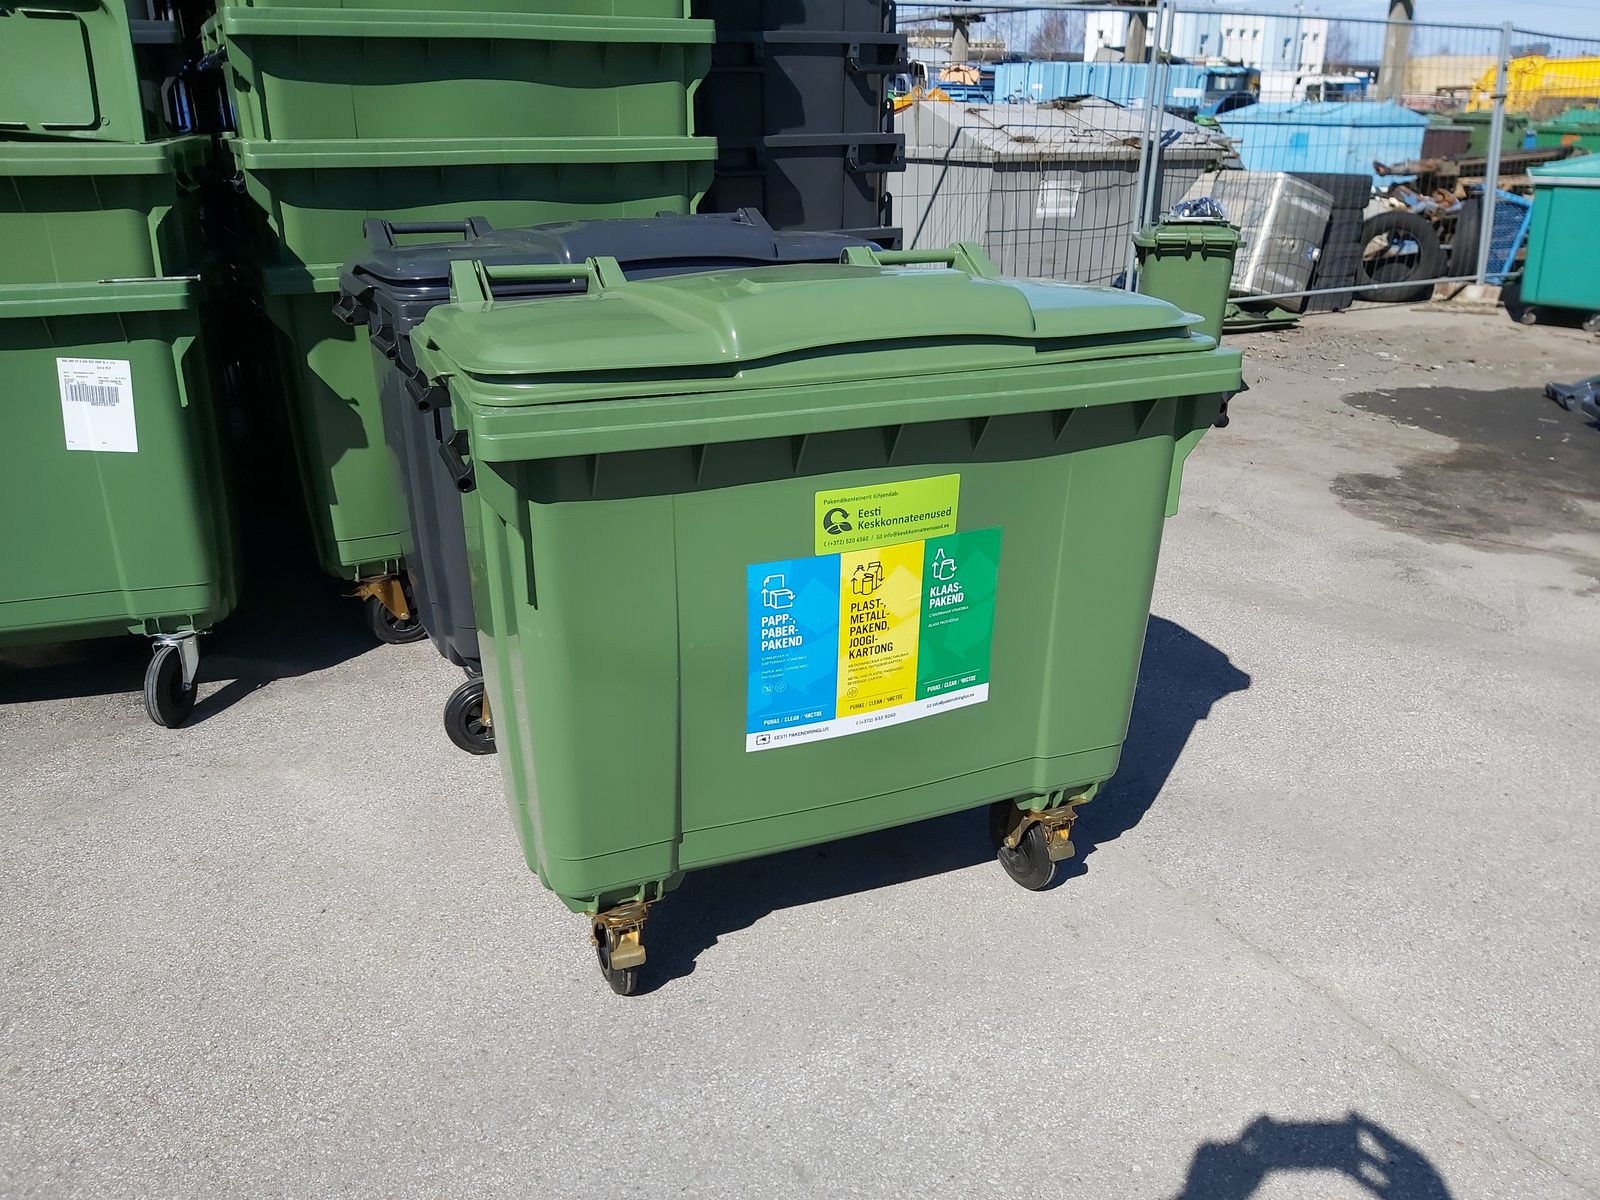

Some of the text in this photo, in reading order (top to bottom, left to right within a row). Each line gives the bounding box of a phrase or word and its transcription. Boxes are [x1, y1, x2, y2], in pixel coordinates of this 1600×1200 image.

[824, 491, 899, 505] Pakendikonteinerit tühjendab:
[858, 507, 881, 518] Eesti
[858, 507, 952, 530] Keskkonnateenused
[828, 538, 844, 547] (+372)
[884, 523, 949, 539] info@keskkonnateenused.ee
[930, 582, 963, 598] KLAAS-
[850, 598, 886, 613] PLAST-,
[929, 592, 964, 609] PAKEND
[761, 613, 796, 628] PAPP-,
[850, 610, 890, 625] METALL-
[761, 625, 799, 640] PABER-
[850, 621, 889, 636] PAKEND,
[761, 635, 803, 651] PAKEND
[849, 636, 878, 649] JOOGI-
[848, 642, 893, 660] KARTONG
[927, 683, 941, 693] PUHAS
[944, 679, 957, 689] CLEAN
[850, 701, 864, 710] PUHAS
[869, 698, 882, 707] CLEAN
[763, 717, 780, 726] PUHAS
[784, 714, 800, 722] CLEAN
[789, 726, 829, 738] PAKENDIRINGLUS
